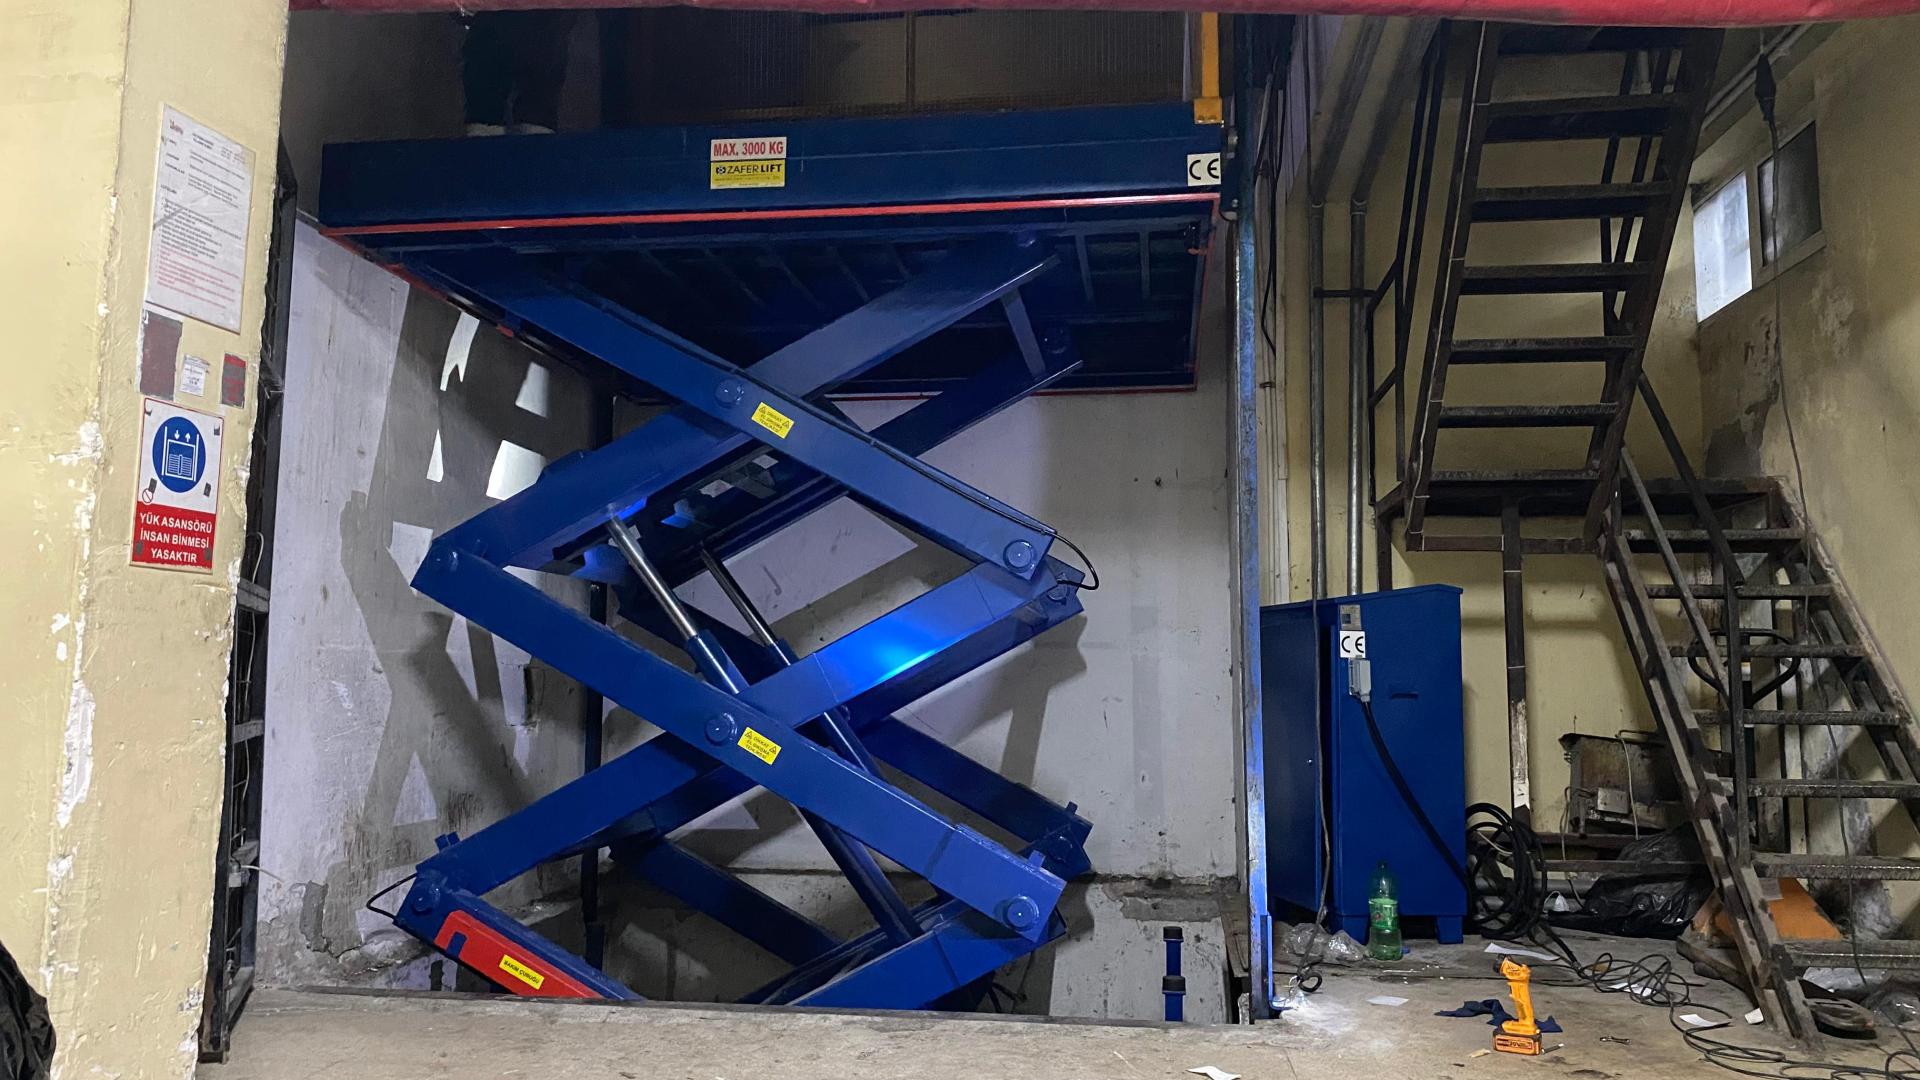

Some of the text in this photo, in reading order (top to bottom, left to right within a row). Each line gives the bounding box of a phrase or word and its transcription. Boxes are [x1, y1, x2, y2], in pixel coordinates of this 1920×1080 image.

[713, 141, 784, 156] MAX. 3000 KG
[1189, 158, 1219, 180] CE
[140, 512, 212, 534] YÜK ASANSÖRÜ
[140, 527, 209, 549] İNSAN BİNMESİ
[151, 548, 197, 563] YASAKTIR
[1341, 635, 1364, 653] CE
